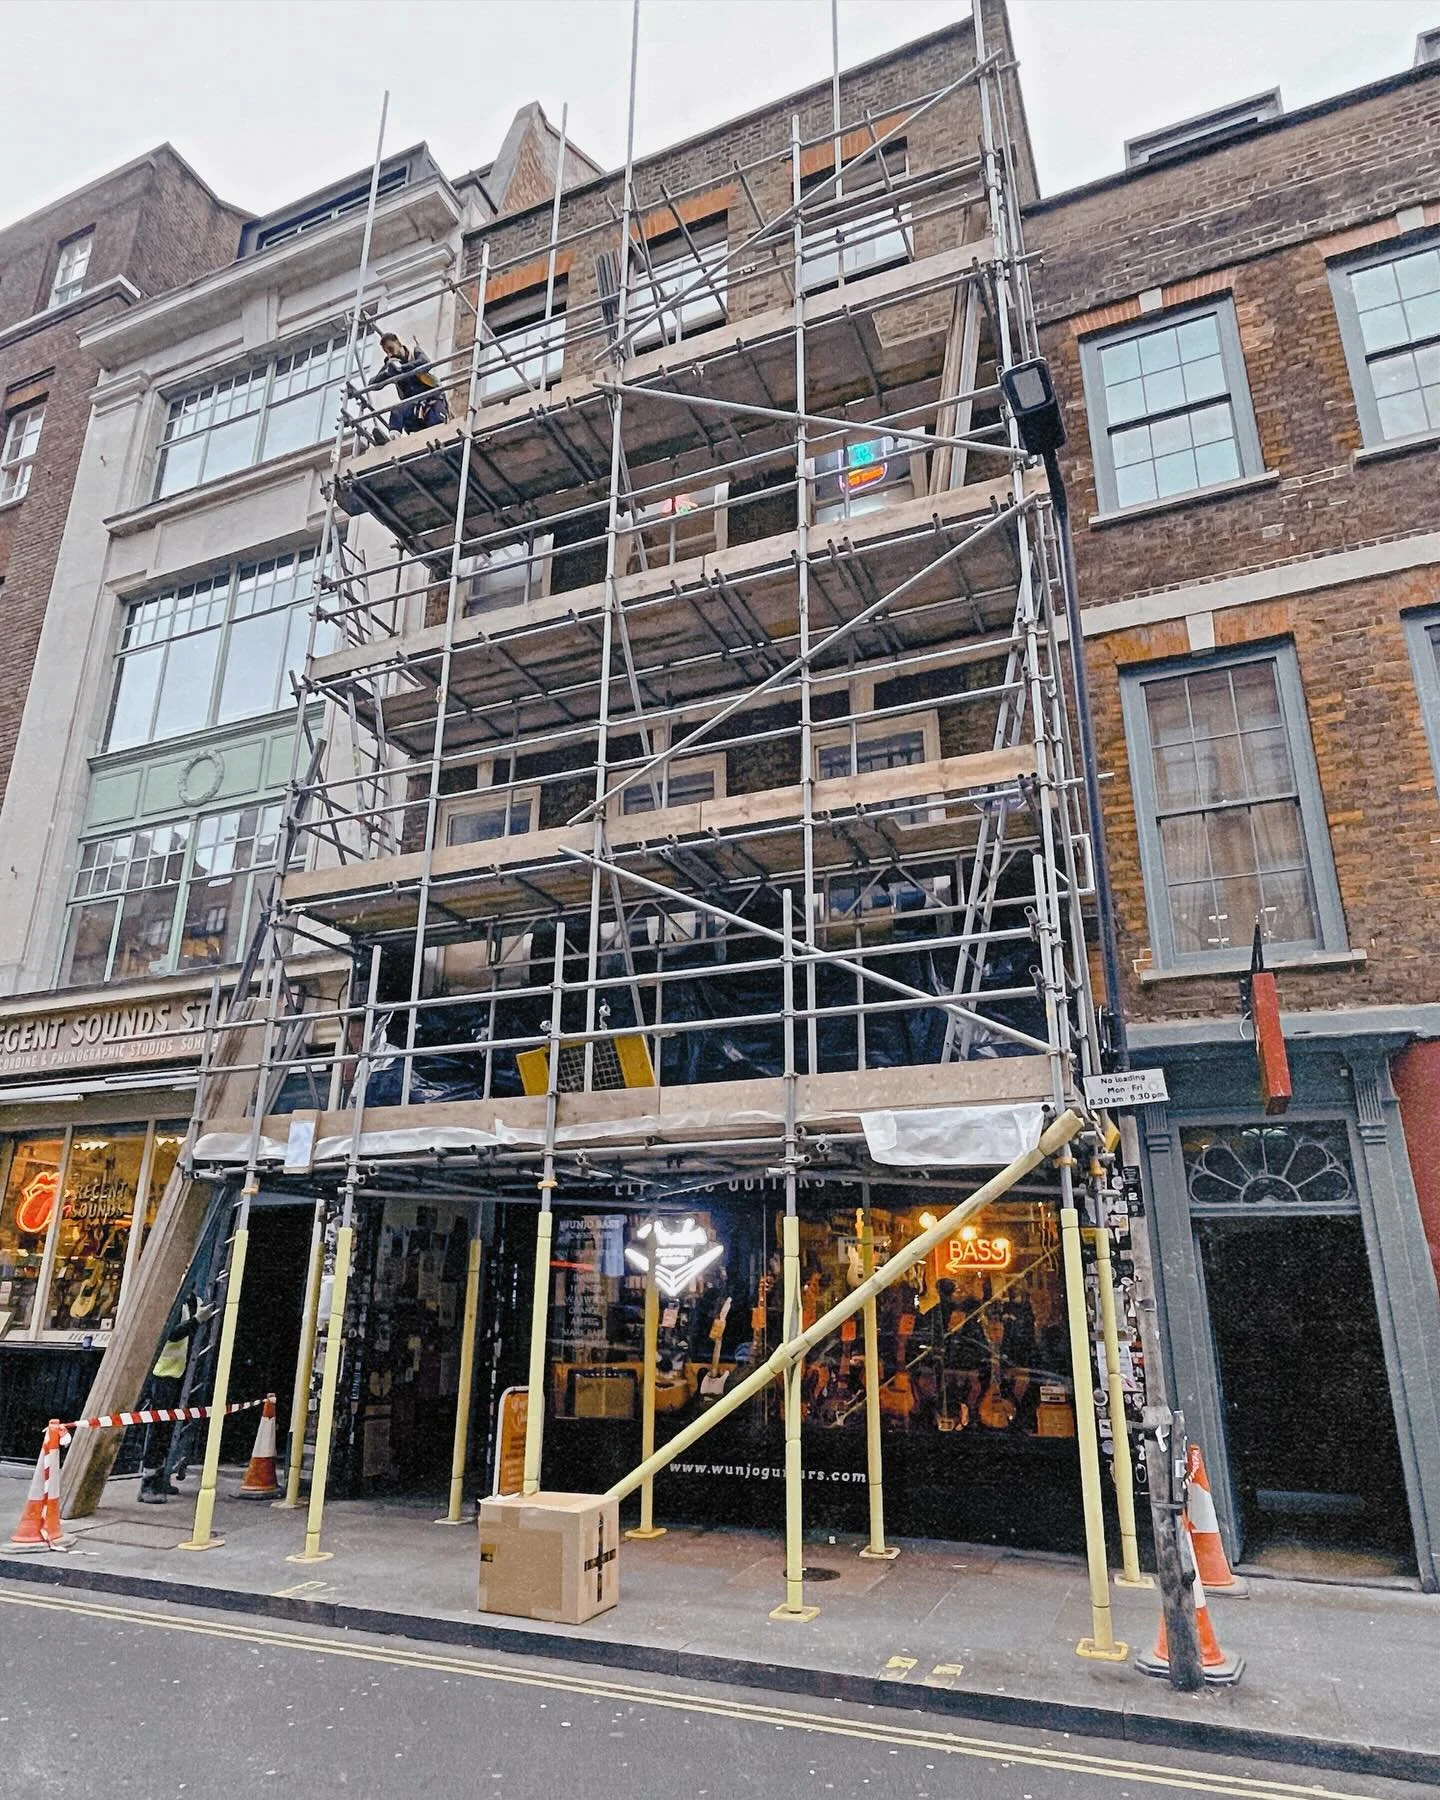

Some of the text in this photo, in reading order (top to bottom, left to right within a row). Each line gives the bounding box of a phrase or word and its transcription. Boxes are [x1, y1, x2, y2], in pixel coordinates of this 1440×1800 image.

[71, 1004, 171, 1045] SOUNDS
[51, 1045, 125, 1065] PHONOGRAPHIC
[131, 1039, 173, 1057] STUDIOS
[1107, 1083, 1143, 1094] Mon Fri
[949, 1239, 1005, 1262] BASS
[670, 1463, 866, 1483] www.wunjogurs.com
